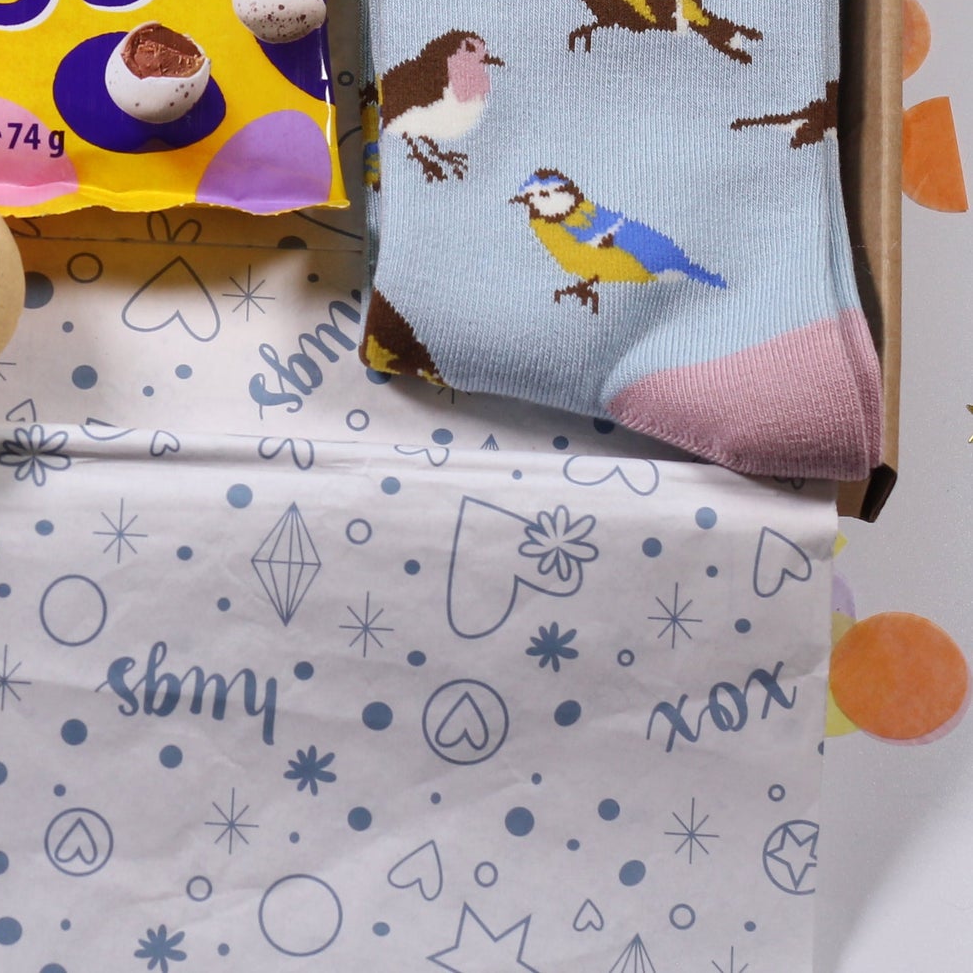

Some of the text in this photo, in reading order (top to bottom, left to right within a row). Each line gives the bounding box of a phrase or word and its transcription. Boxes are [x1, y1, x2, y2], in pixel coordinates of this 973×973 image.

[7, 122, 41, 150] 74
[48, 129, 65, 158] g
[95, 641, 277, 746] hugs
